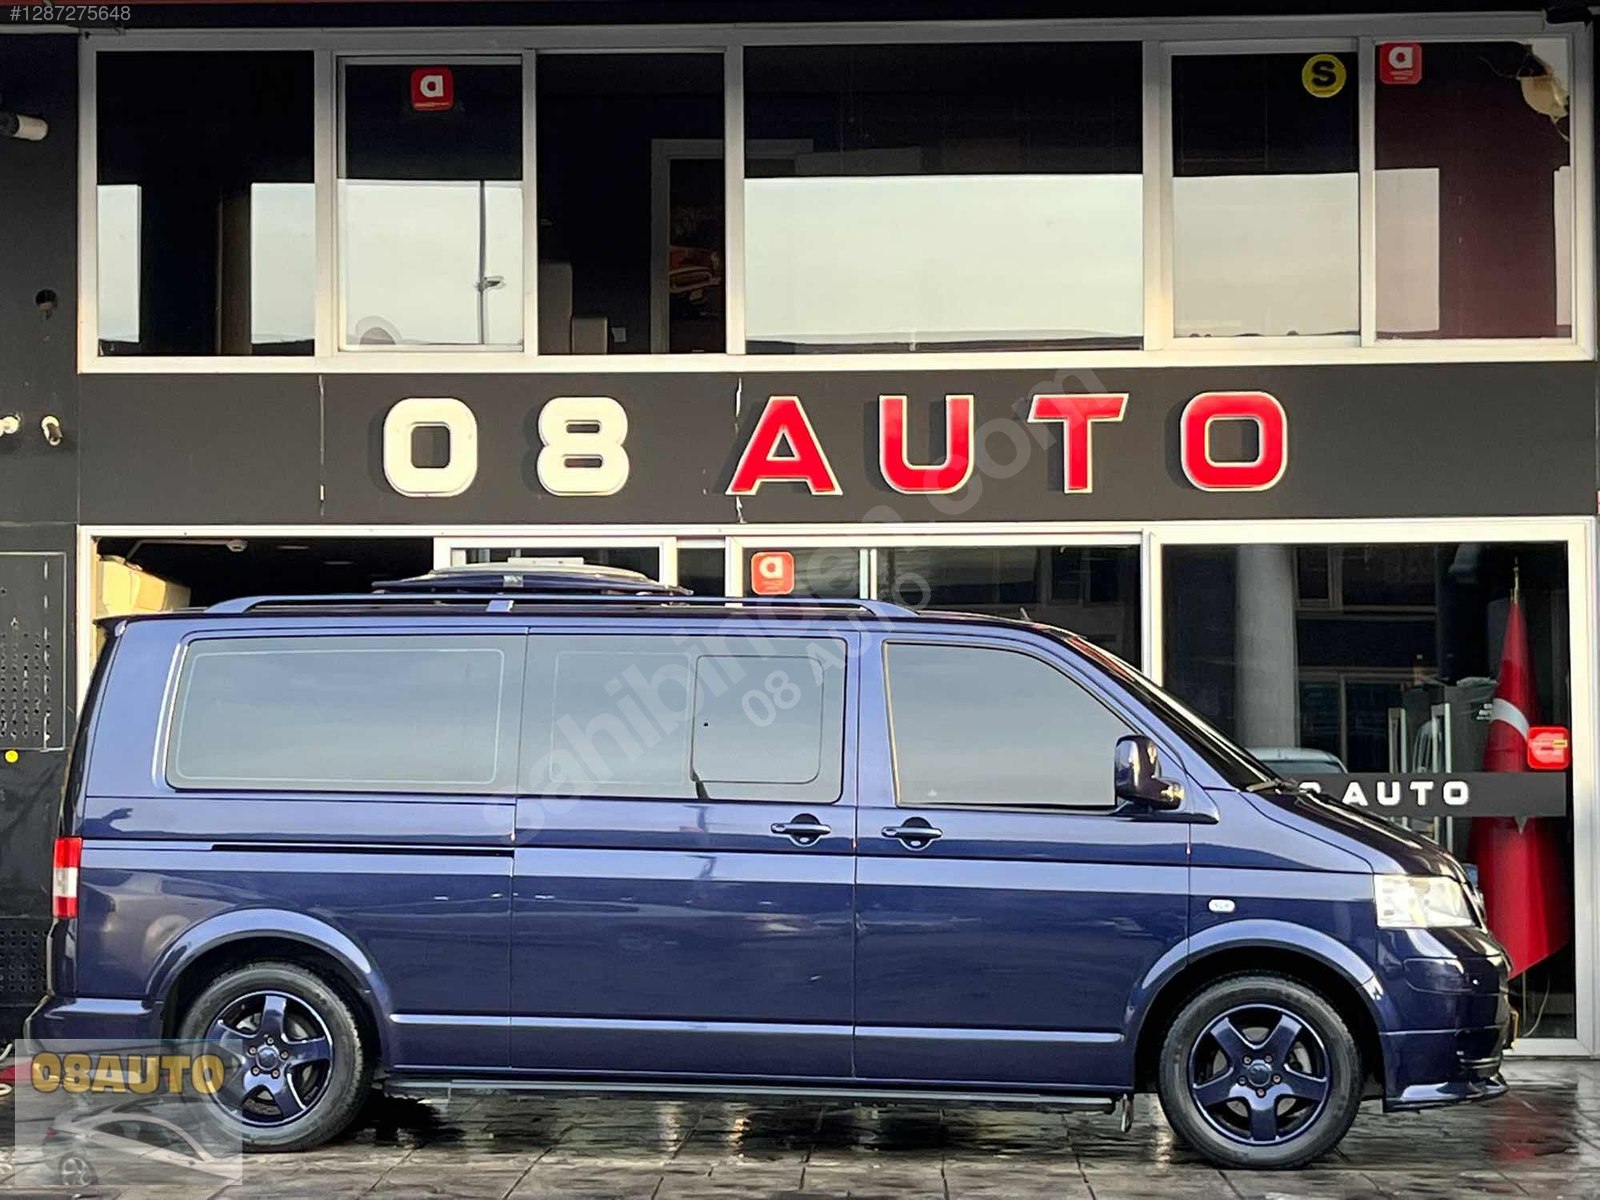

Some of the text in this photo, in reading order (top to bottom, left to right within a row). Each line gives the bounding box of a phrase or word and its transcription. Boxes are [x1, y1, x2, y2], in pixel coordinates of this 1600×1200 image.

[383, 391, 1288, 498] 08 AUTO
[1342, 781, 1469, 806] AUTO
